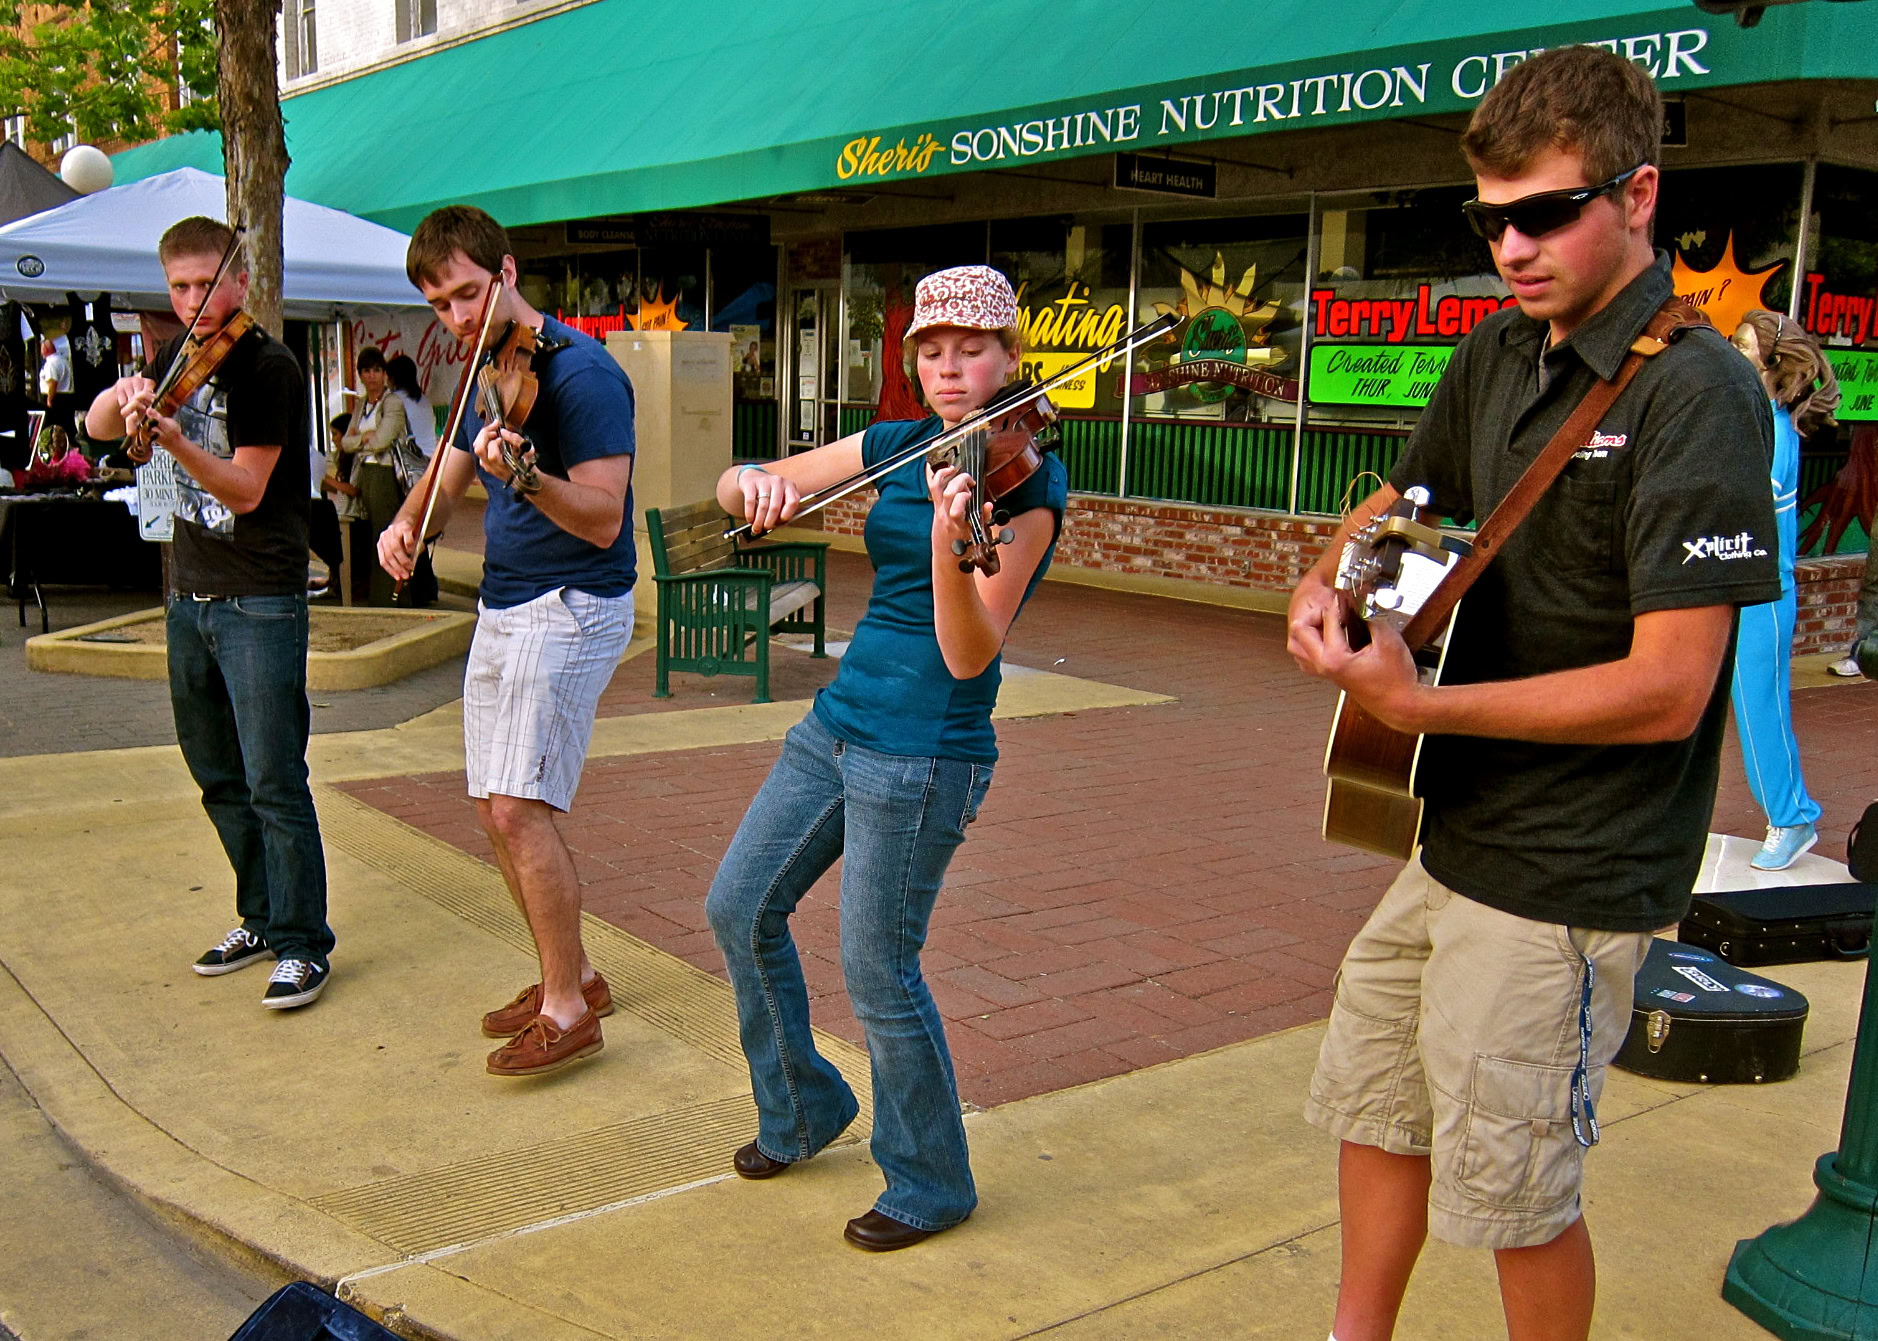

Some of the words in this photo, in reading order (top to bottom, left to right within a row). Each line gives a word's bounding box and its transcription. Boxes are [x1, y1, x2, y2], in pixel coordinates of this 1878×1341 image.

[950, 104, 1141, 166] SONSHINE
[1157, 62, 1433, 136] NUTRITION
[1451, 28, 1711, 99] CEER
[1130, 168, 1164, 185] HEART
[1166, 173, 1204, 190] HEALTH
[1312, 288, 1416, 343] Terry
[1415, 283, 1521, 337] Lem
[1806, 273, 1873, 345] Terry
[1213, 362, 1286, 396] NUTRITION
[1326, 349, 1405, 376] Created
[1408, 351, 1450, 379] Terr
[1403, 381, 1437, 400] JUN
[142, 469, 173, 485] PARKI
